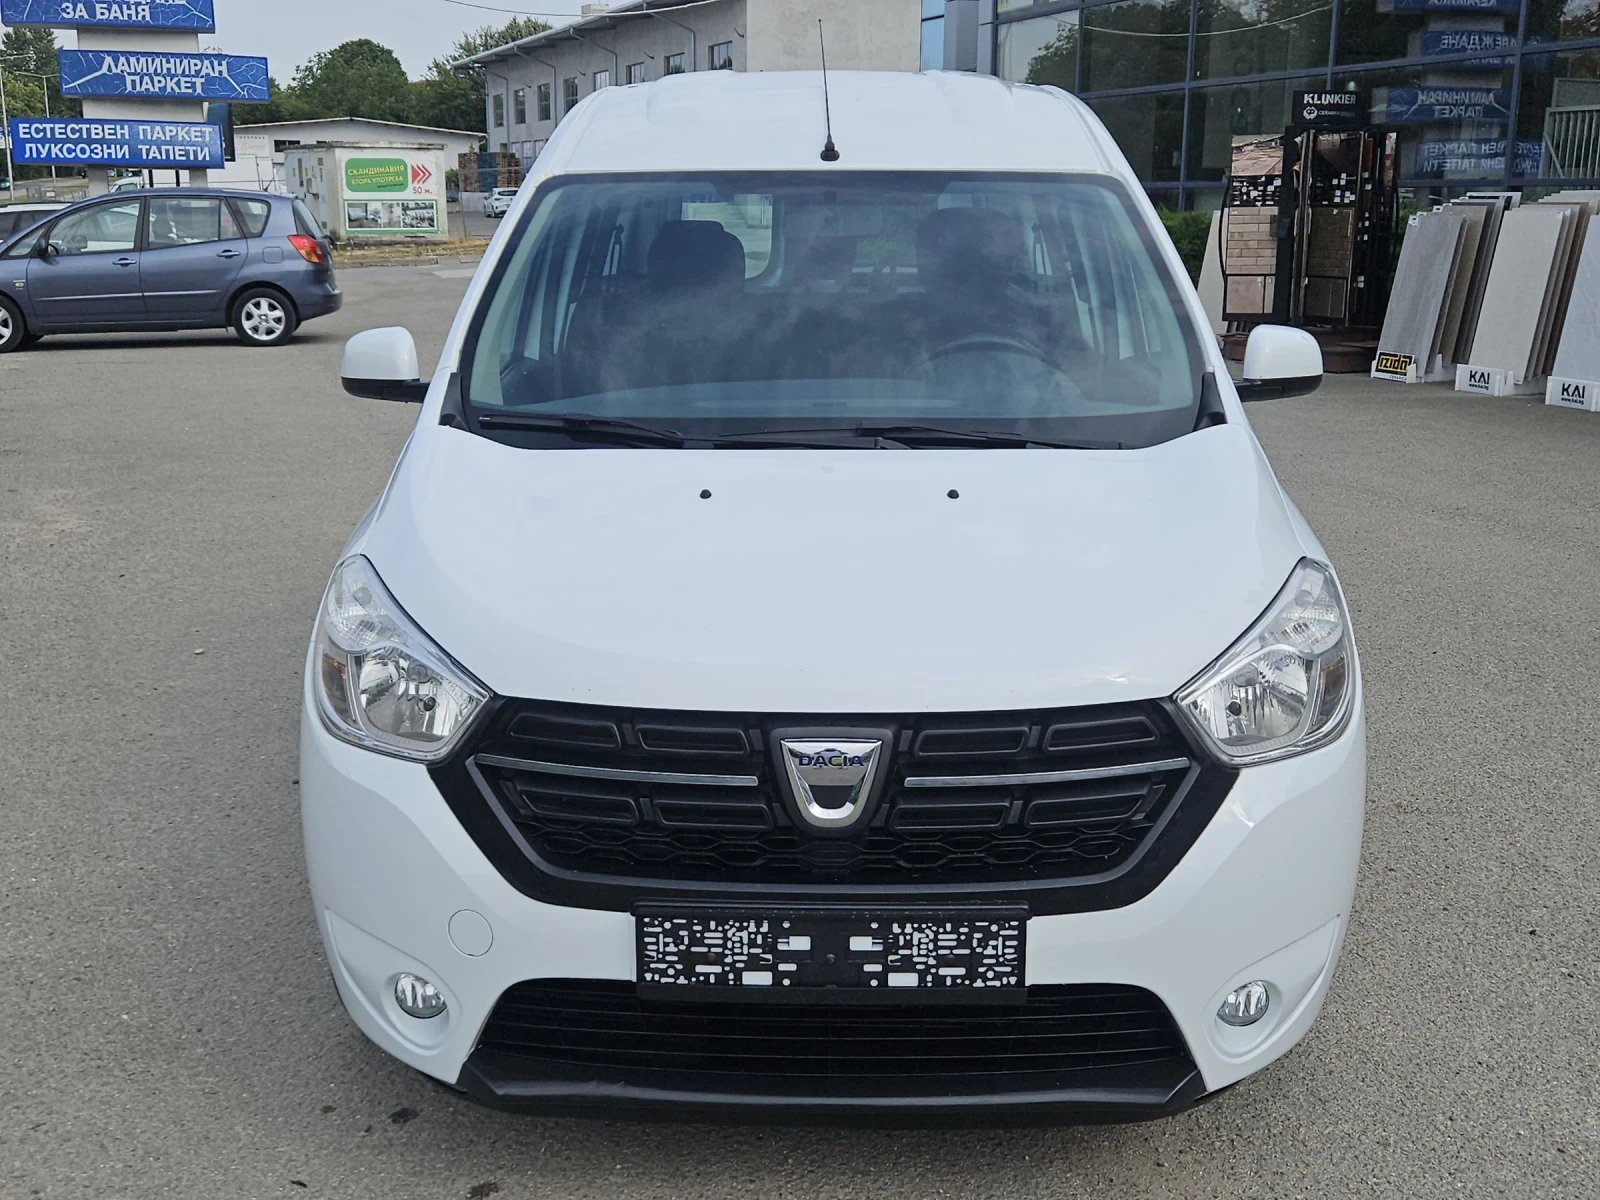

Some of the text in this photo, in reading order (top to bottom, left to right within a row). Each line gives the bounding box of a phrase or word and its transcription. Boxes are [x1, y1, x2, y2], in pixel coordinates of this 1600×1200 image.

[61, 4, 151, 21] ЗА БАНЯ
[101, 56, 229, 77] ЛАМИНИРАН
[126, 76, 205, 93] ПАРКЕТ
[1303, 93, 1356, 104] KLINKIER
[18, 122, 213, 142] ЕСТЕСТВЕН ПАРКЕТ
[24, 143, 211, 161] ЛУКСОЗНИ ТАПЕТИ
[347, 165, 405, 176] СКАНДИНАВИЯ
[412, 187, 422, 195] 50
[1469, 370, 1490, 385] KAI
[1561, 383, 1586, 399] KAI
[798, 755, 864, 767] DACIA
